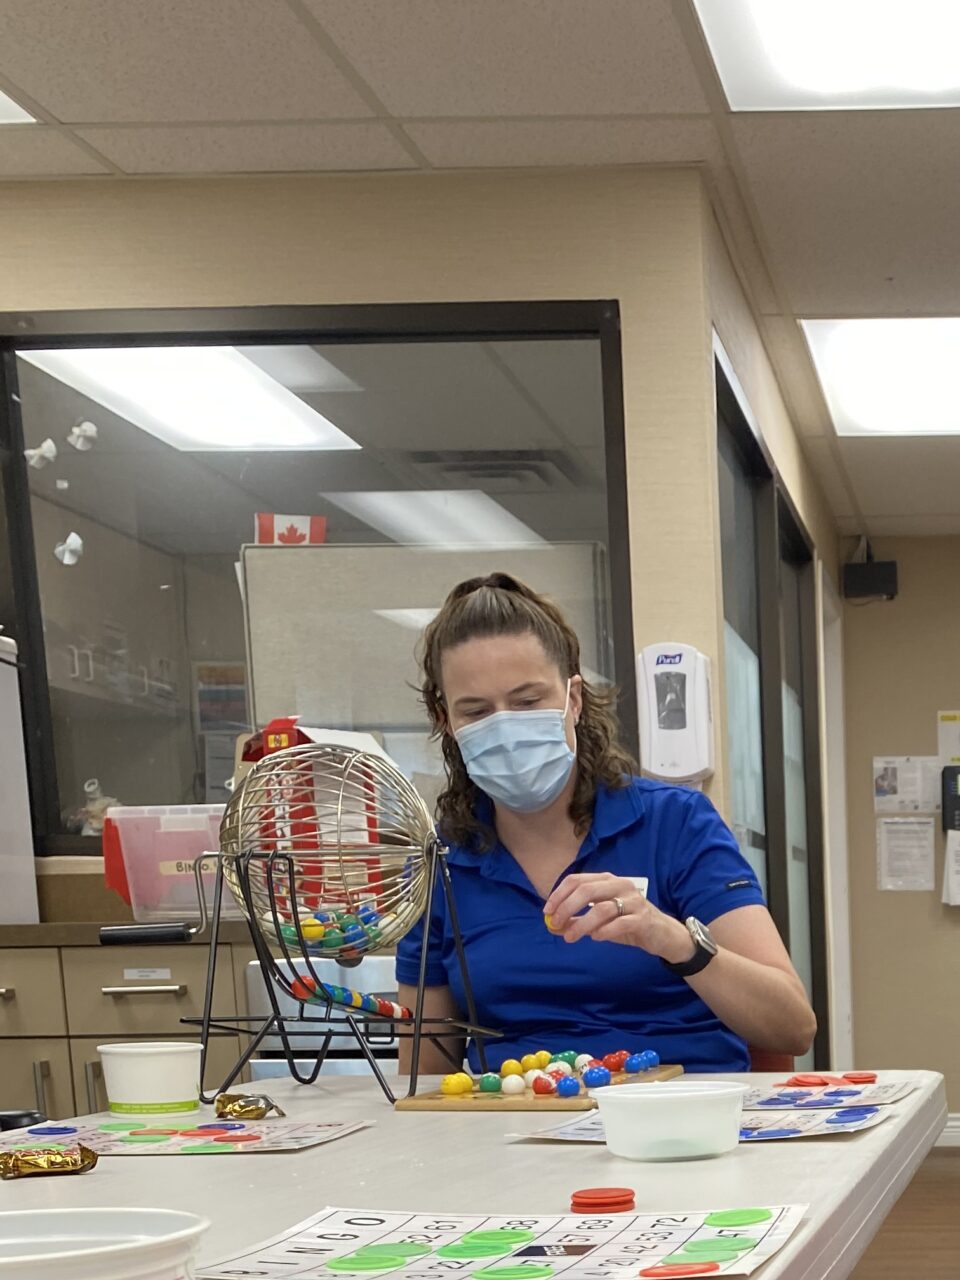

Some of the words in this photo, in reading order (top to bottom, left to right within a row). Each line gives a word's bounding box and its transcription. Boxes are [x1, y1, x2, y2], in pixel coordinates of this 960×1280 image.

[424, 1220, 464, 1231] 61
[650, 1217, 688, 1228] 72
[557, 1233, 593, 1243] 57
[575, 1219, 614, 1230] 69
[635, 1231, 674, 1242] 53
[428, 1260, 475, 1270] 22
[500, 1219, 539, 1230] 68
[620, 1244, 658, 1254] 42
[598, 1257, 641, 1268] 20
